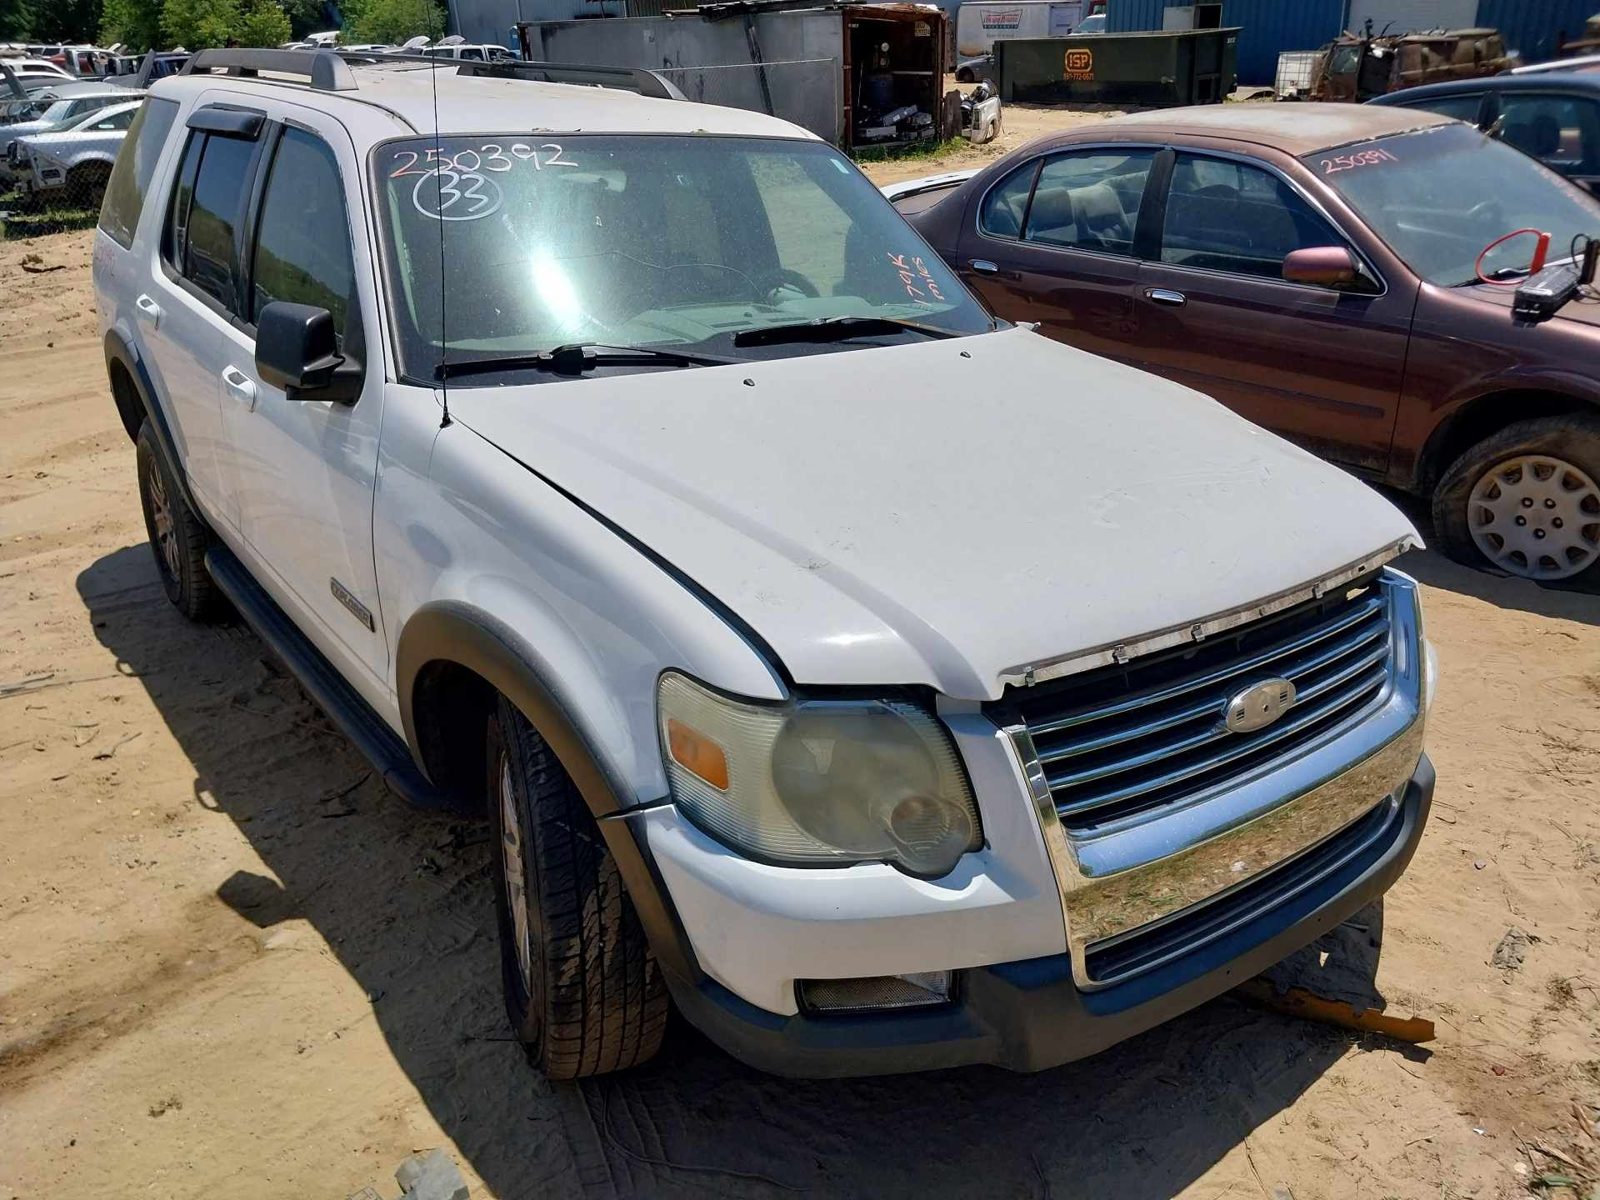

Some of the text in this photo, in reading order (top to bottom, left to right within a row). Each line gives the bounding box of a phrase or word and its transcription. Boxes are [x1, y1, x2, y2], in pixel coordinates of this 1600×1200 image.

[1068, 54, 1089, 67] ISP
[390, 143, 579, 178] 250392
[1320, 148, 1400, 175] 250391
[433, 171, 489, 212] 33
